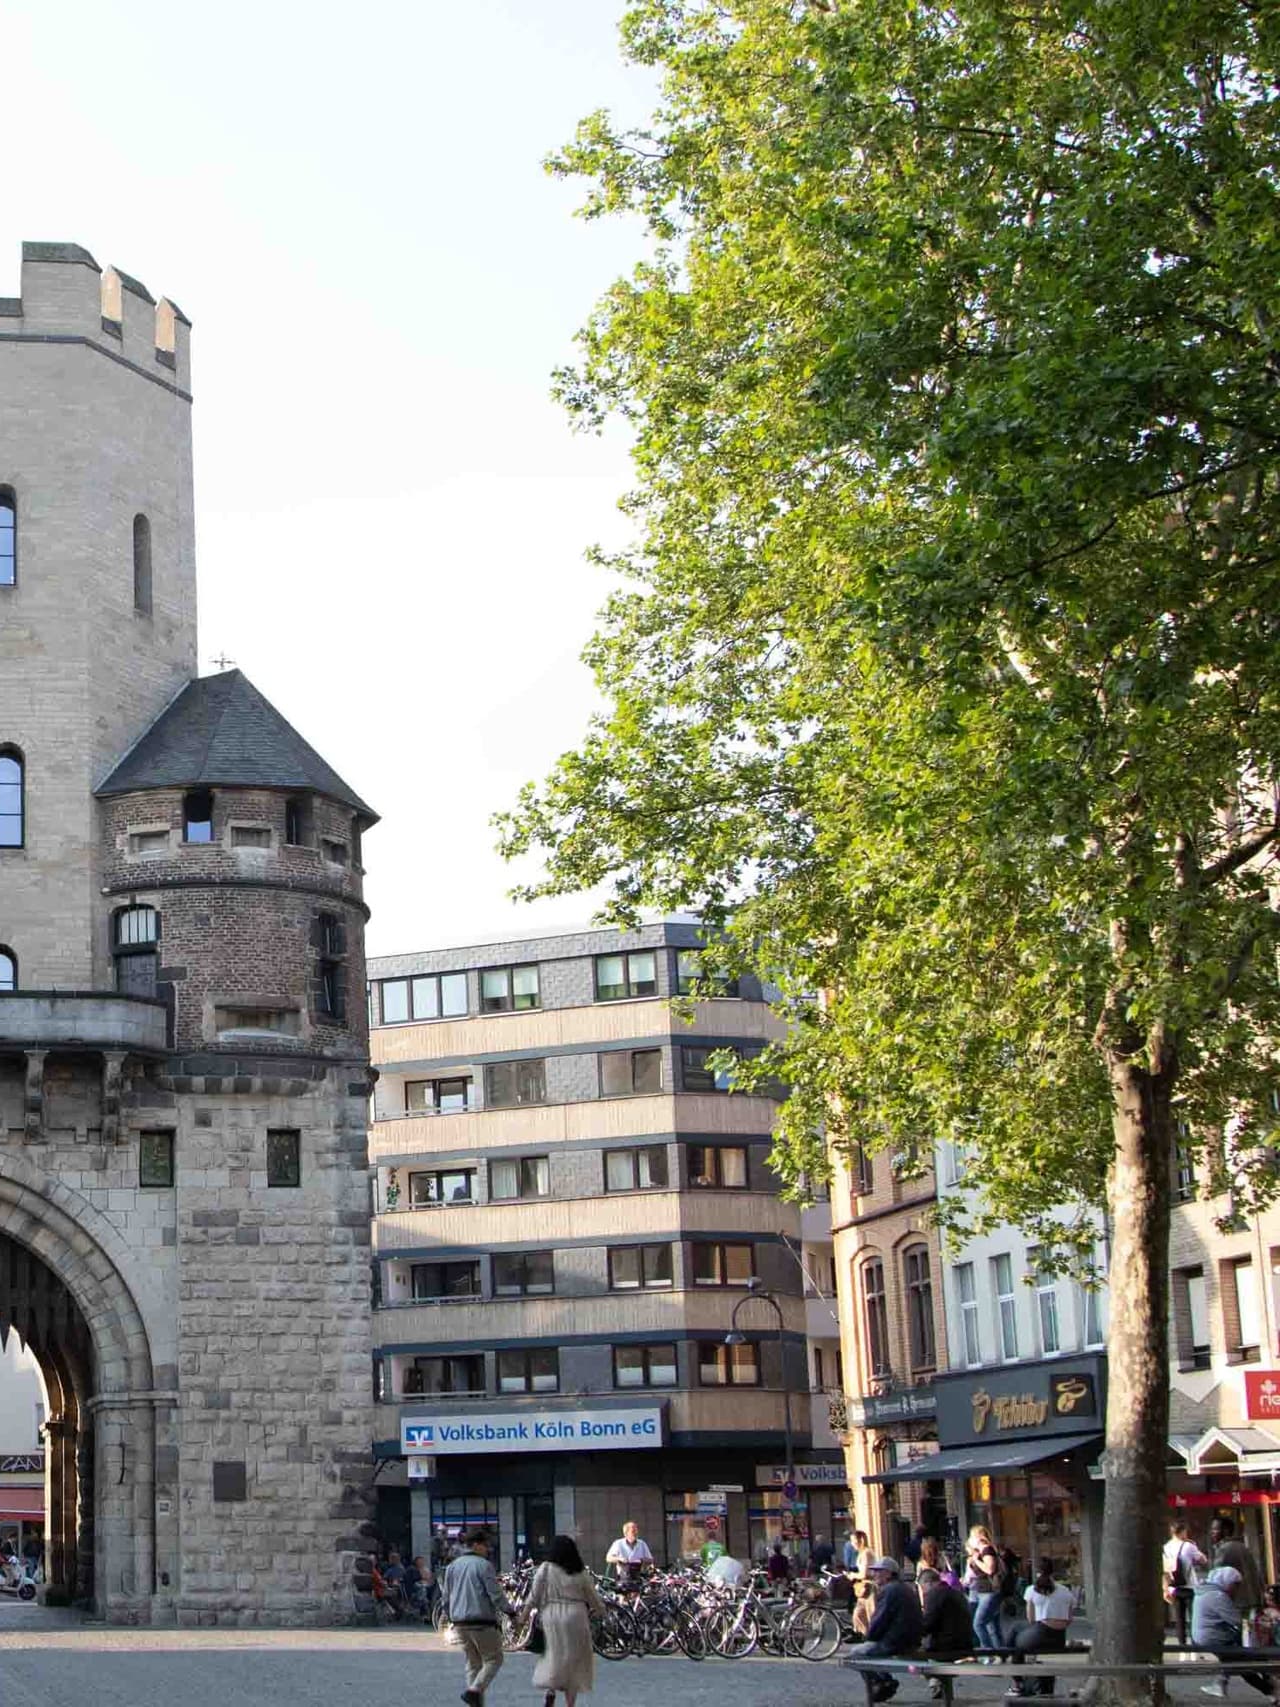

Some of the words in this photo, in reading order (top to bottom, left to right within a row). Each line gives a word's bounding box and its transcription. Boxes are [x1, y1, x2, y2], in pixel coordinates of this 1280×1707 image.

[438, 1422, 528, 1441] Volksbank
[534, 1421, 574, 1438] Köln
[581, 1419, 626, 1436] Bonn
[631, 1418, 656, 1435] eG
